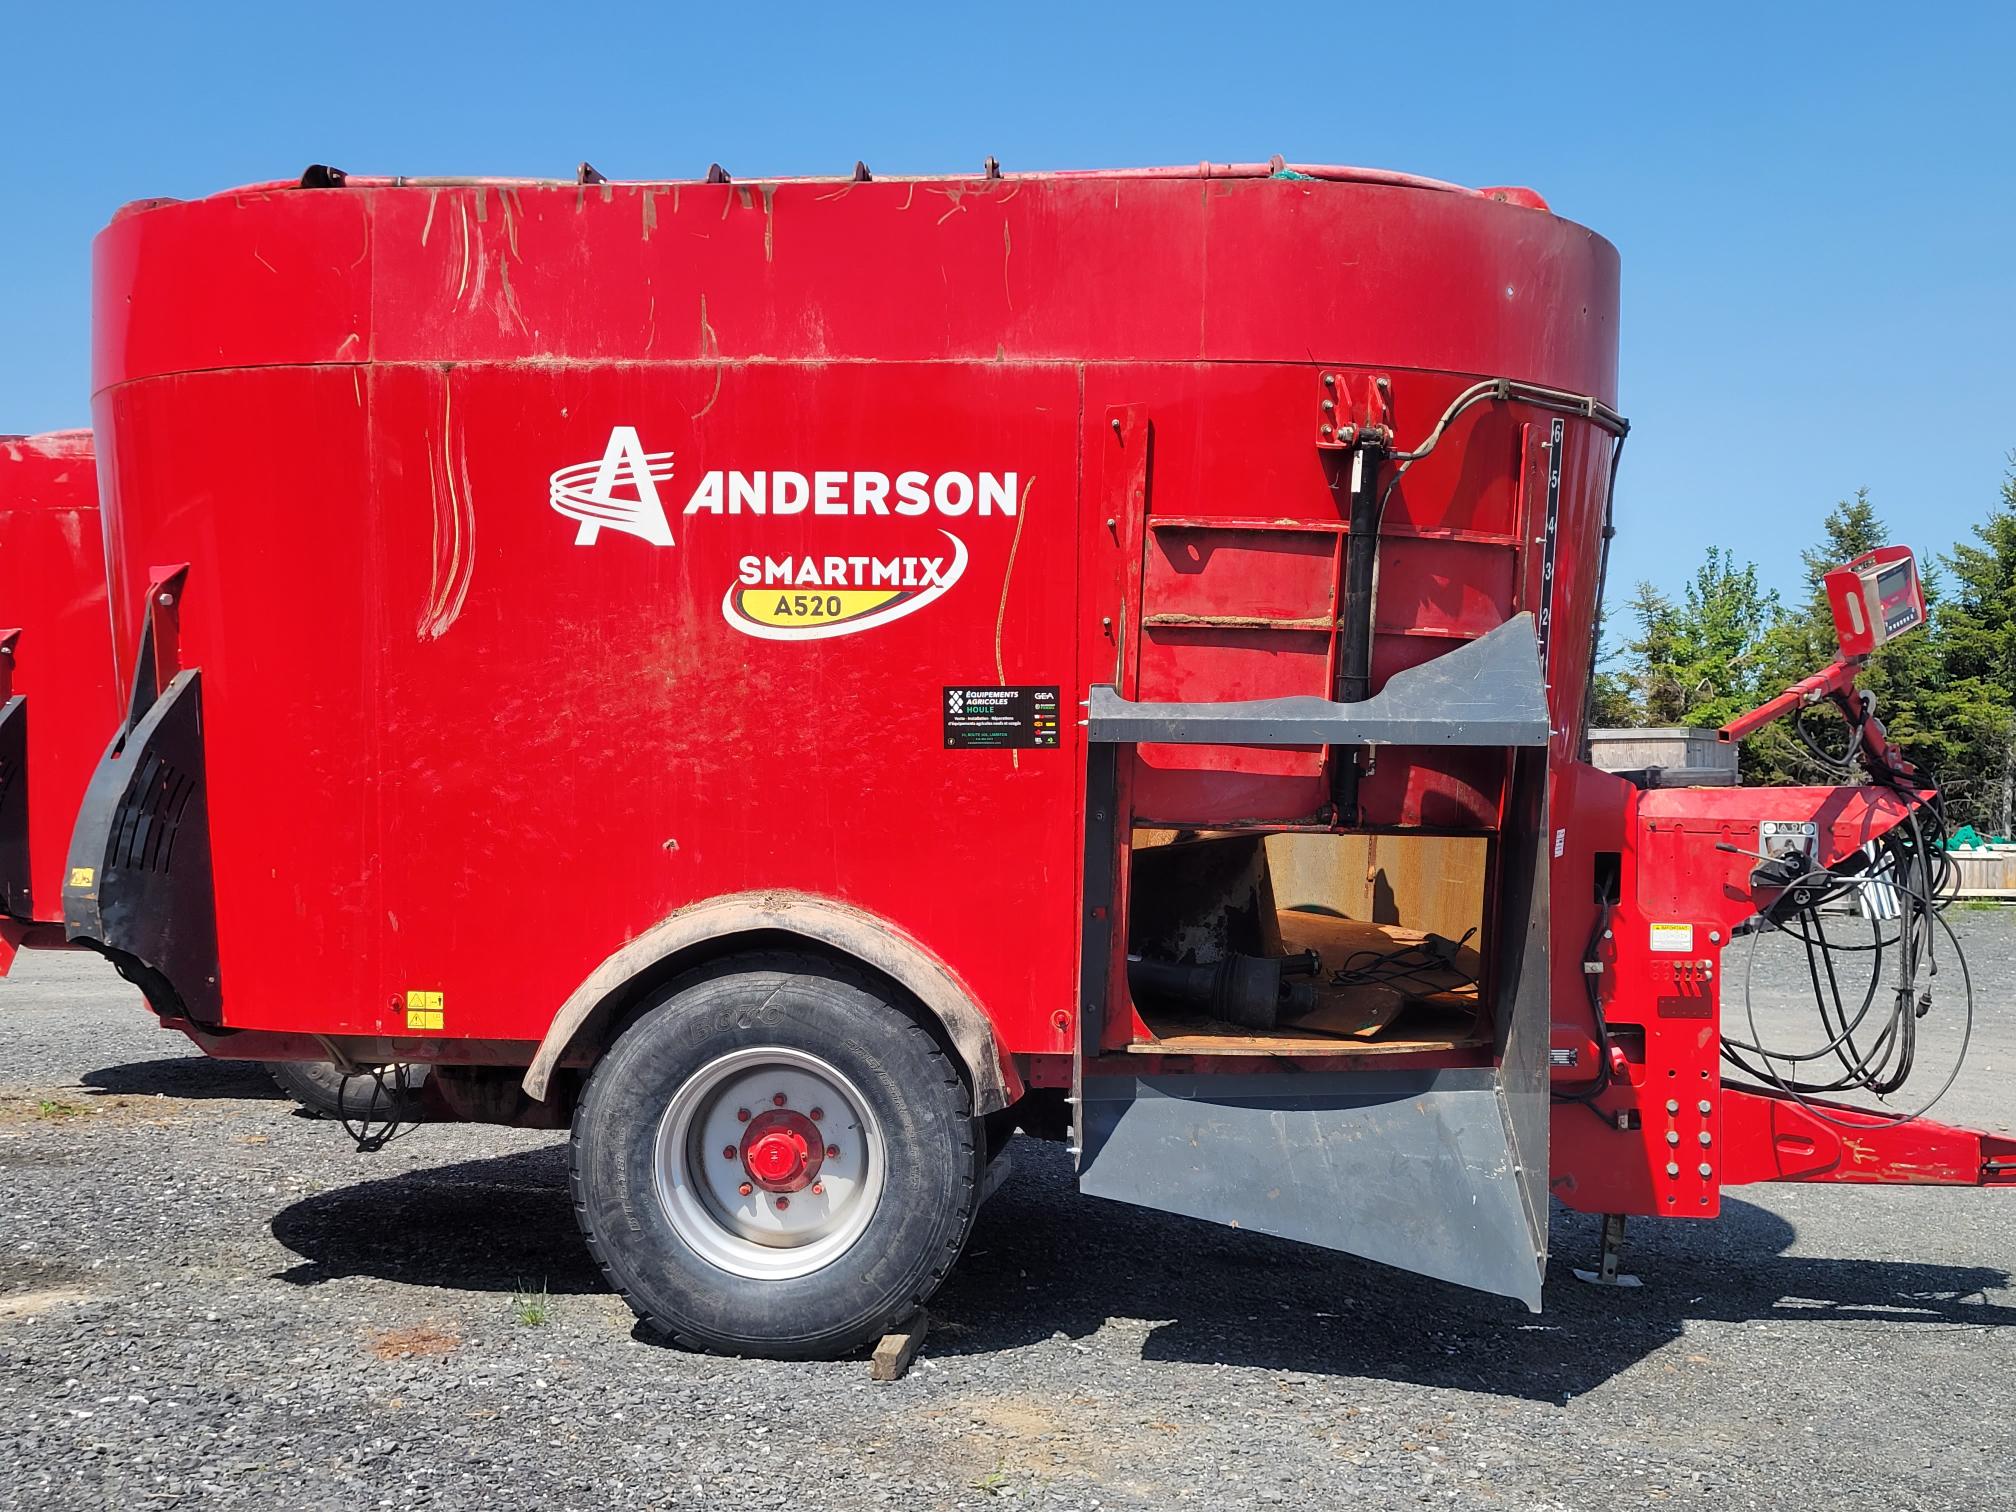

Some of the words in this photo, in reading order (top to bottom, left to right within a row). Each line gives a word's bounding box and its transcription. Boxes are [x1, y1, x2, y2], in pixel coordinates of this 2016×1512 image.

[1554, 425, 1561, 443] 6
[1551, 471, 1558, 488] 5
[683, 470, 1018, 516] ANDERSON
[1548, 517, 1555, 534] 4
[739, 555, 944, 588] SMARTMIX
[1544, 562, 1551, 580] 3
[773, 595, 842, 617] A520
[1541, 608, 1549, 626] 2
[965, 690, 1019, 698] ÉQUIPEMENTS
[1034, 692, 1055, 700] GEA
[966, 706, 995, 714] HOULE
